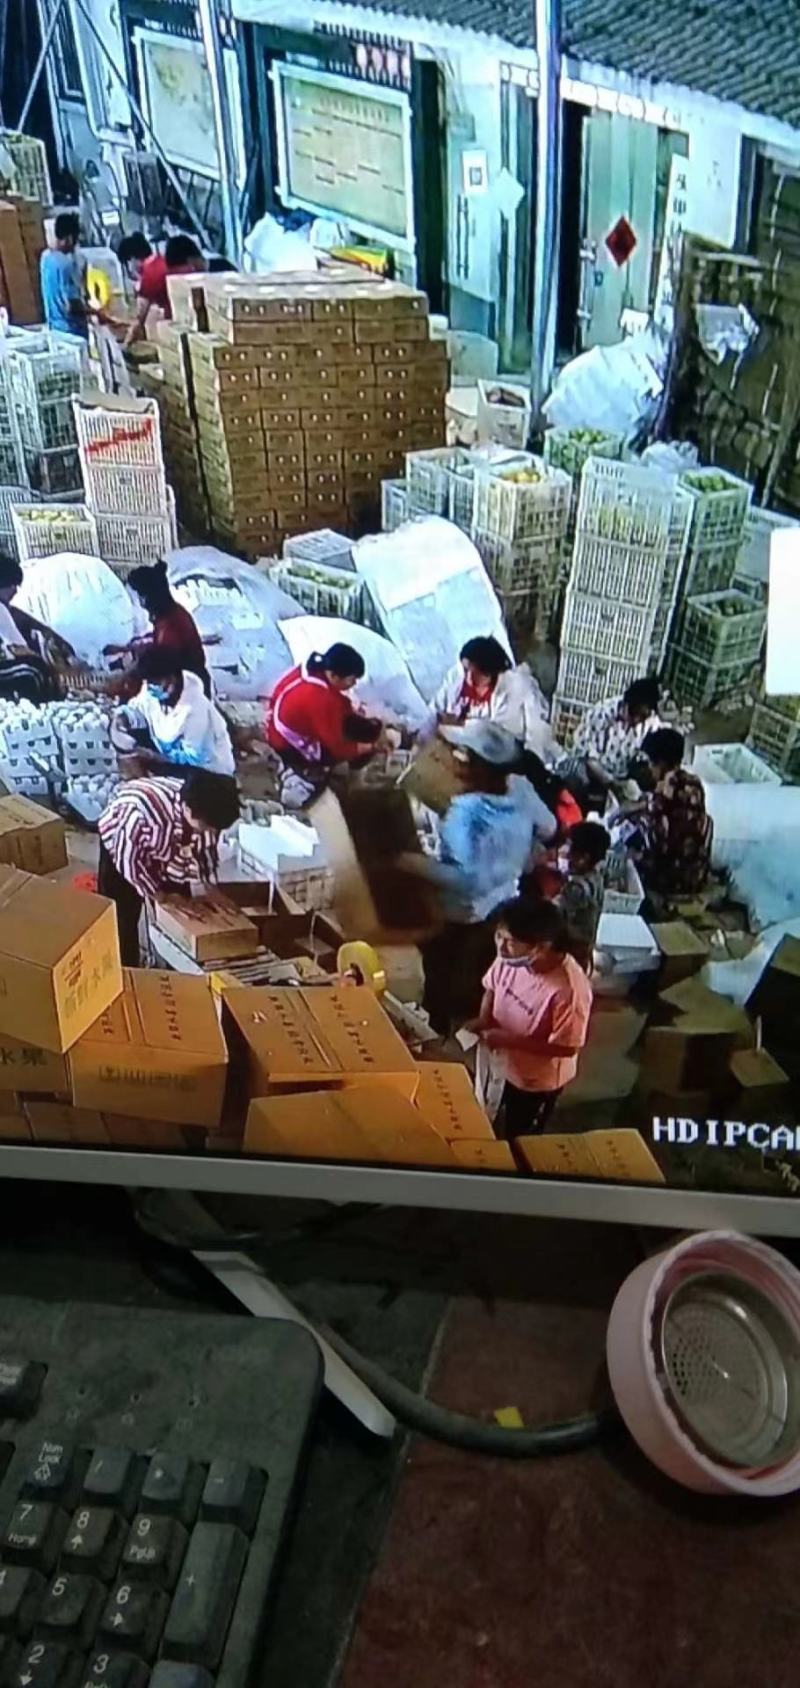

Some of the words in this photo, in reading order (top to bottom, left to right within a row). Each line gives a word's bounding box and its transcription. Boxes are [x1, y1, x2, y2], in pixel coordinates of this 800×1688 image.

[652, 1116, 800, 1151] HDIPCA
[20, 1503, 33, 1520] 7
[76, 1511, 90, 1529] 8
[137, 1518, 151, 1537] 9
[52, 1577, 68, 1596] 5
[116, 1585, 131, 1605] 6
[27, 1644, 45, 1664] 2
[93, 1654, 109, 1674] 3
